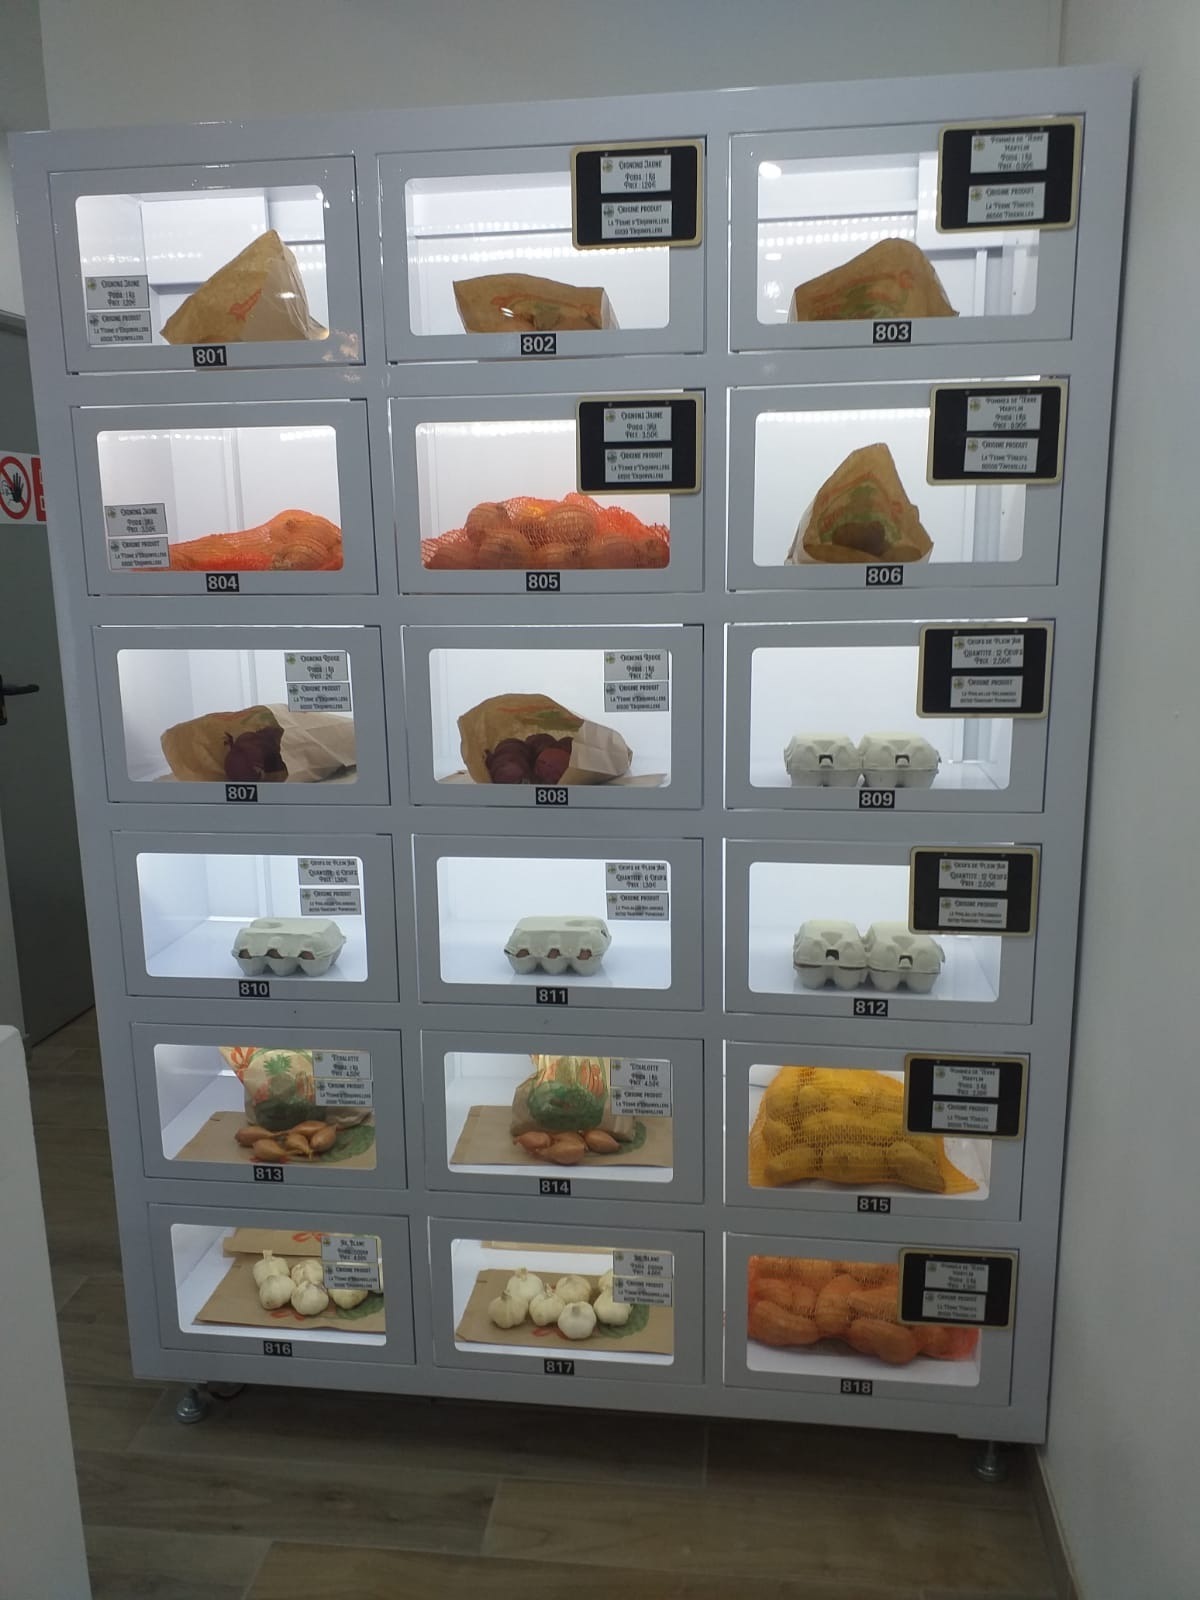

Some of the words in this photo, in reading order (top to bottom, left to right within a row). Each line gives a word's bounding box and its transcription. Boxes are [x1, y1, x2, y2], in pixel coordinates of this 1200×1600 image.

[875, 323, 910, 341] 803
[522, 335, 555, 353] 802
[195, 348, 225, 365] 801
[207, 575, 238, 590] 804
[528, 573, 559, 590] 805
[867, 567, 902, 584] 806
[228, 786, 255, 800] 807
[537, 789, 567, 804] 808
[861, 791, 893, 807] 809
[240, 982, 269, 996] 810
[539, 989, 566, 1003] 811
[855, 1000, 887, 1015] 812
[255, 1167, 283, 1181] 813
[541, 1180, 569, 1194] 814
[859, 1197, 889, 1212] 815
[265, 1342, 291, 1355] 816
[546, 1360, 573, 1373] 817
[842, 1380, 871, 1394] 818
